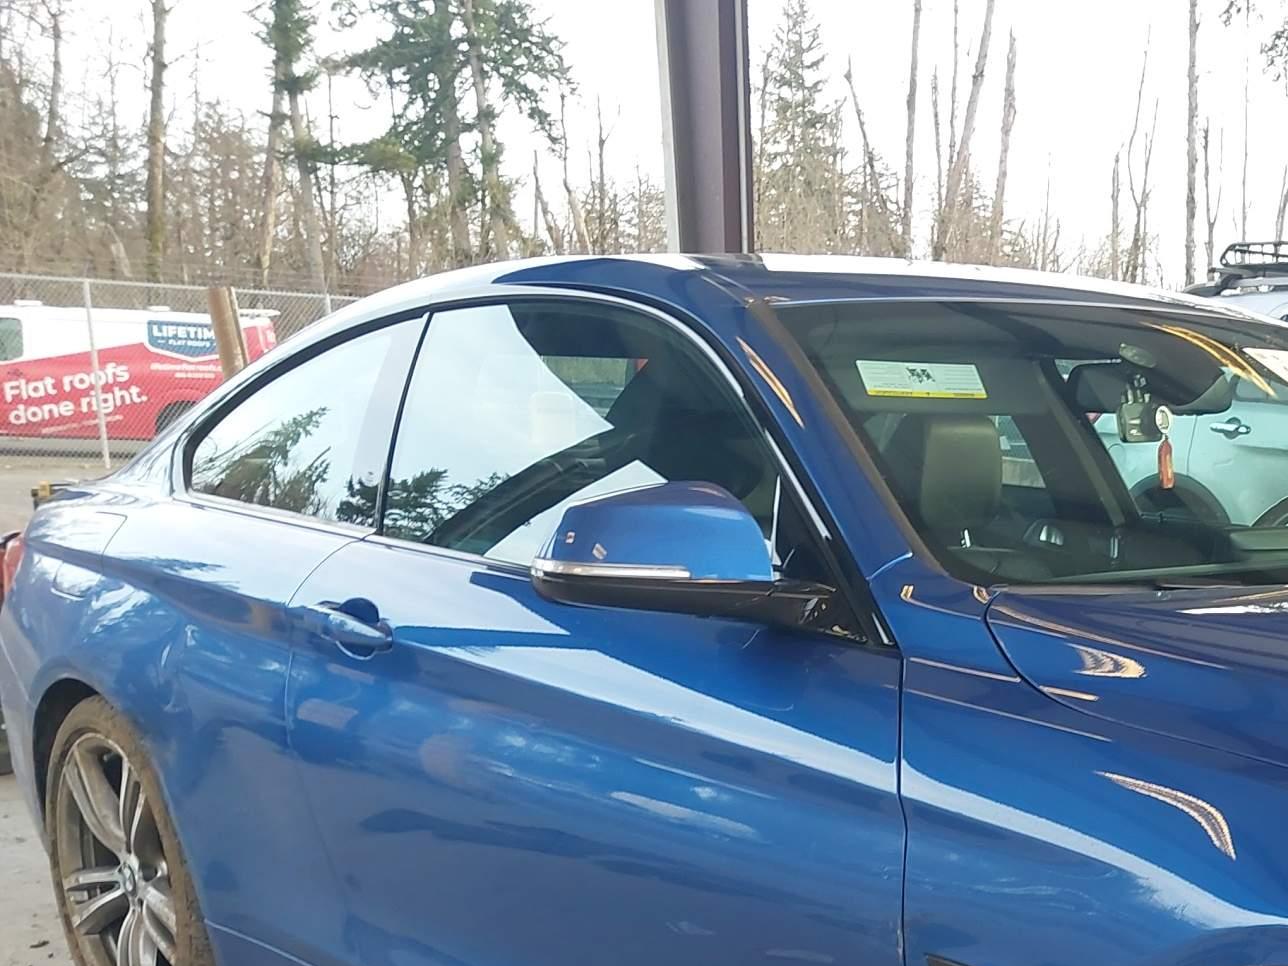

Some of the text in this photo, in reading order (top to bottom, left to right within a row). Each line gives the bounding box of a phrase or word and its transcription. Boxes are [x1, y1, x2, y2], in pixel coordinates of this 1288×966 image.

[3, 362, 129, 403] Flat roofs
[8, 400, 75, 425] done
[80, 385, 149, 414] right.
